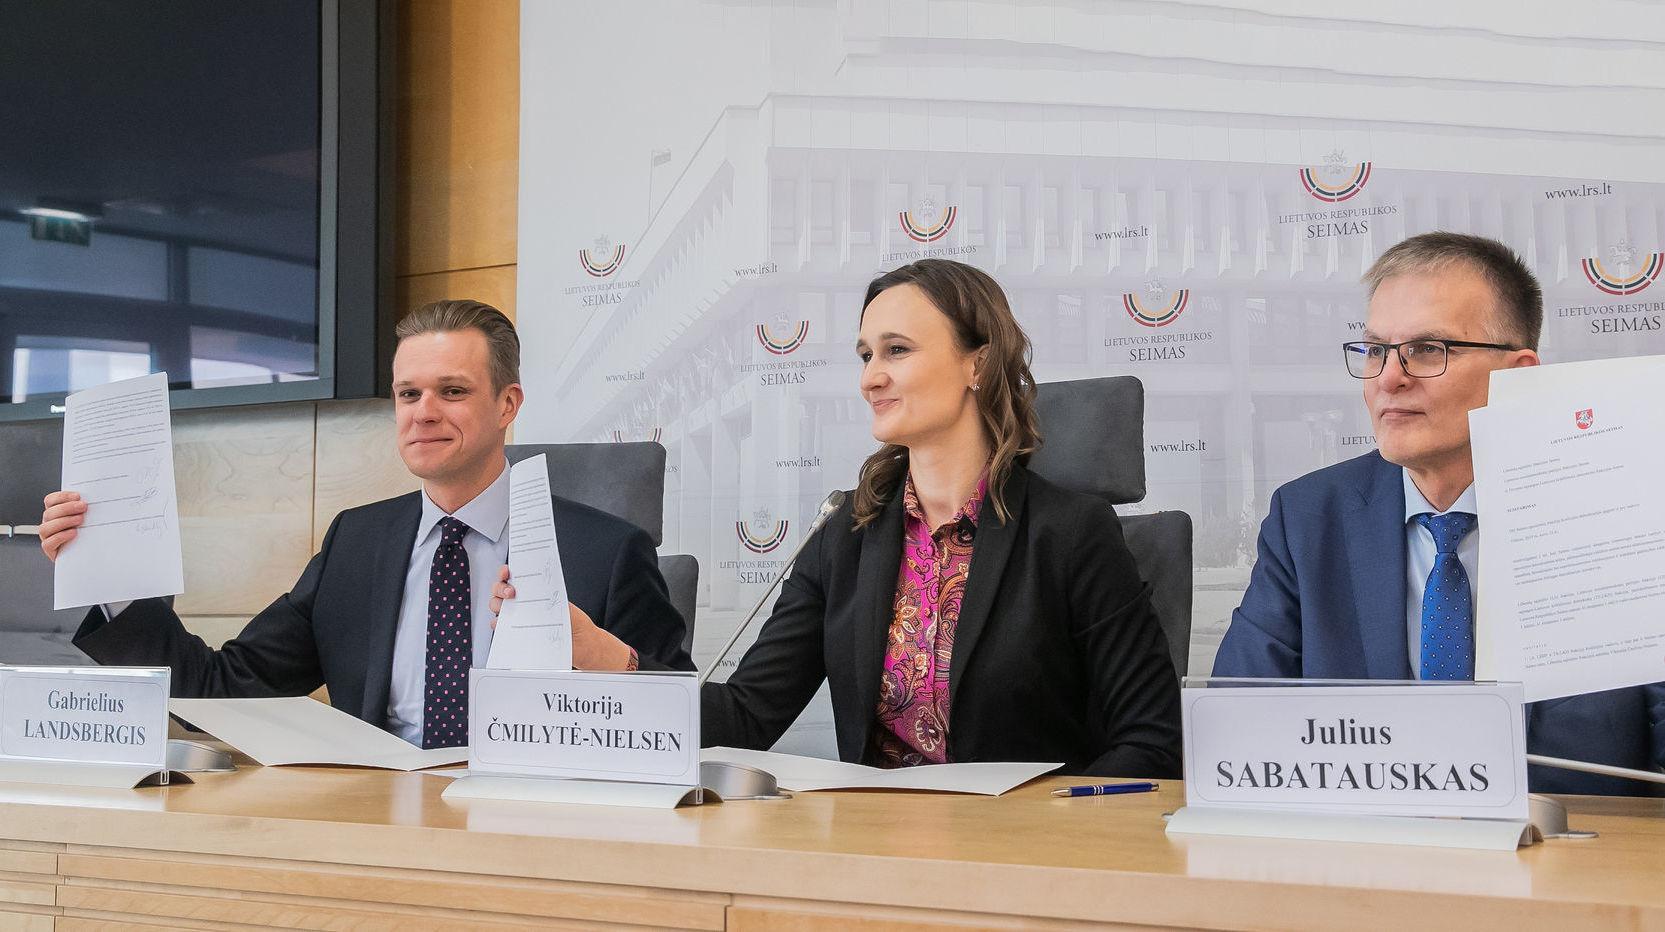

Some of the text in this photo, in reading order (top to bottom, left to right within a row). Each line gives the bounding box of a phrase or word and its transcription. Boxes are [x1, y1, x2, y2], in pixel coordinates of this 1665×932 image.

[1545, 182, 1611, 199] www.lrs.lt
[1279, 205, 1397, 224] LIETUVOS RESPUBLIKOS
[1095, 226, 1148, 240] www.lrs.lt
[1307, 220, 1368, 238] SEIMAS
[882, 245, 977, 261] LIETUVOS RESPUBLIKOS
[735, 263, 777, 276] www.lrs.lt
[582, 292, 622, 307] SEIMAS
[1559, 305, 1614, 317] LIETUVOS
[1591, 315, 1661, 334] SEIMAS
[1104, 331, 1212, 347] LIETUVOS RESPUBLIKOS
[1129, 345, 1186, 362] SEIMAS
[741, 359, 827, 373] LIETUVOS RESPUBLIKOS
[605, 370, 645, 382] www.lrs.lt
[760, 371, 806, 386] SEIMAS
[1150, 439, 1206, 452] www.lrs.lt
[776, 457, 820, 468] www.lrs.lt
[720, 561, 756, 569] LIETUVOS
[740, 571, 780, 584] SEIMA
[48, 690, 124, 713] Gabrielius
[543, 693, 623, 720] Viktorija
[24, 719, 146, 746] LANDSBERGIS
[487, 717, 682, 752] ČMILYTĖ-NIELSEN
[1301, 718, 1392, 745] Julius
[1216, 760, 1490, 792] SABATAUSKAS
